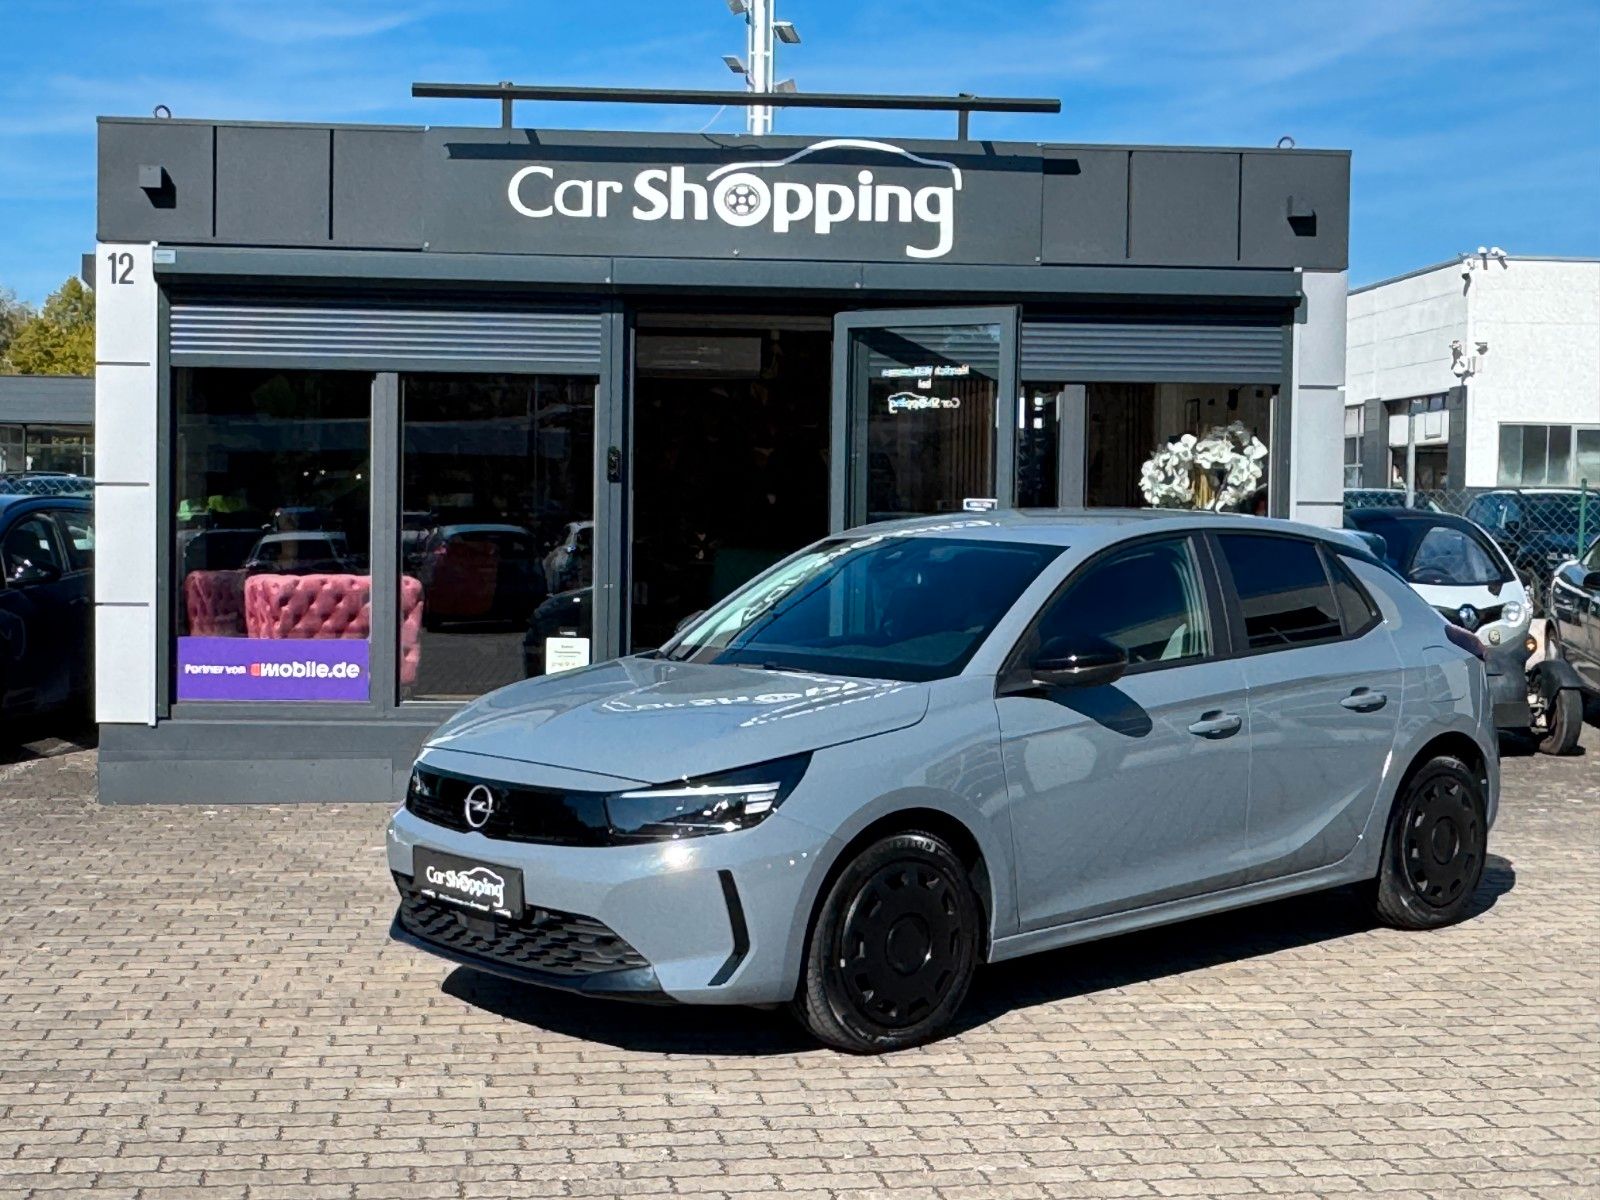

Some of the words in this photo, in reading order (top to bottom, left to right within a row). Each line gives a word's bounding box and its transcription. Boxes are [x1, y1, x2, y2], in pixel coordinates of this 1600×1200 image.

[507, 165, 623, 218] Car
[107, 252, 135, 285] 12
[260, 661, 361, 679] mobile.de
